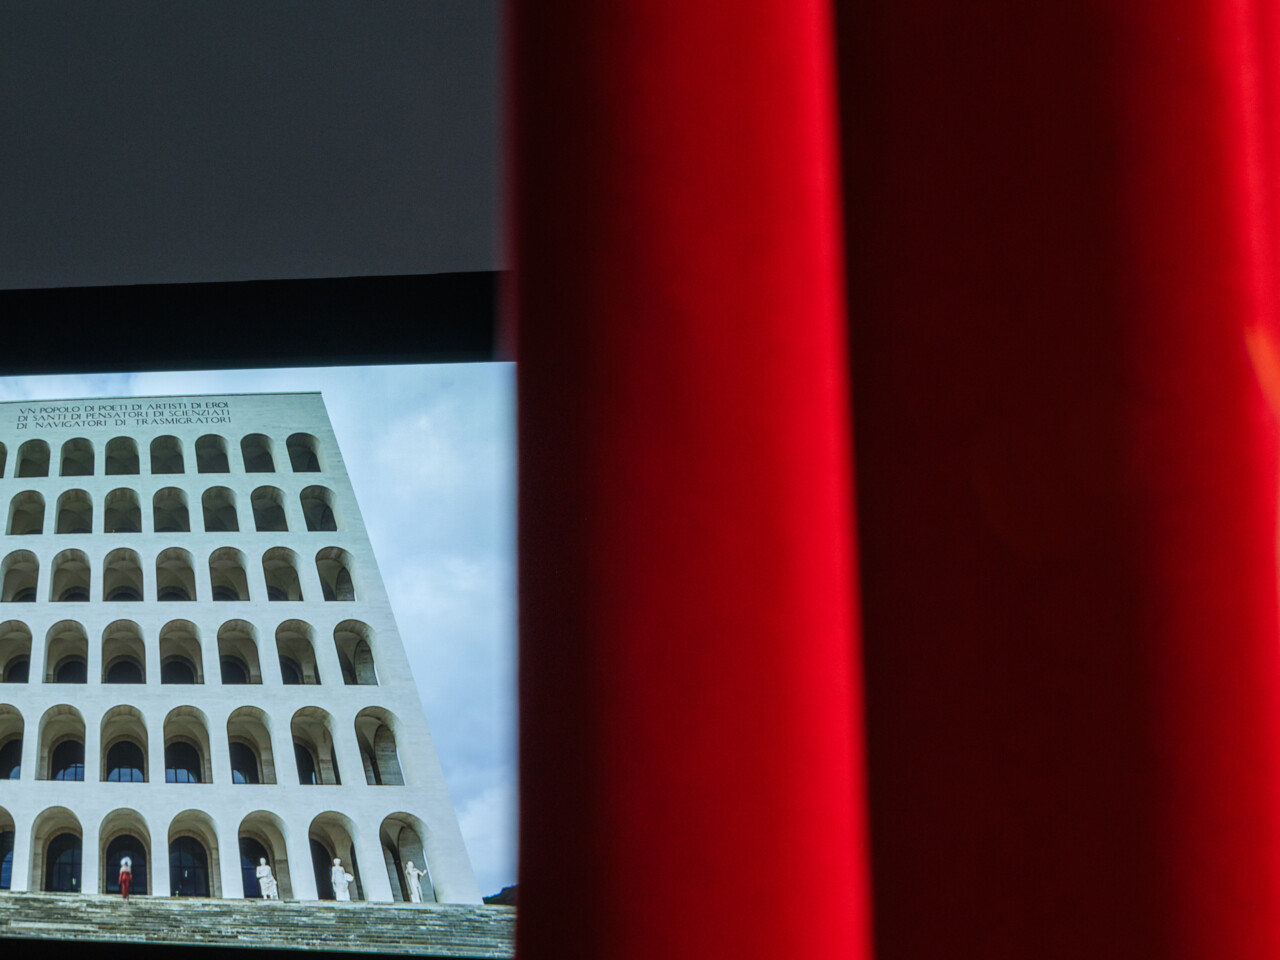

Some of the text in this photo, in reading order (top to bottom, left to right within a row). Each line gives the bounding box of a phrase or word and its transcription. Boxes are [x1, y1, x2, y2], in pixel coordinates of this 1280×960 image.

[39, 406, 80, 414] POPOLO
[131, 403, 142, 411] DI
[146, 402, 186, 410] ARTISTI
[205, 401, 229, 409] EROI
[32, 413, 66, 421] SANTI
[86, 411, 148, 420] PENSATORI
[153, 410, 164, 418] DI
[168, 409, 230, 417] SCIENZIATI
[16, 422, 27, 430] DI
[35, 419, 107, 429] NAVIGATORI
[134, 416, 231, 425] TRASMIGRATORI
